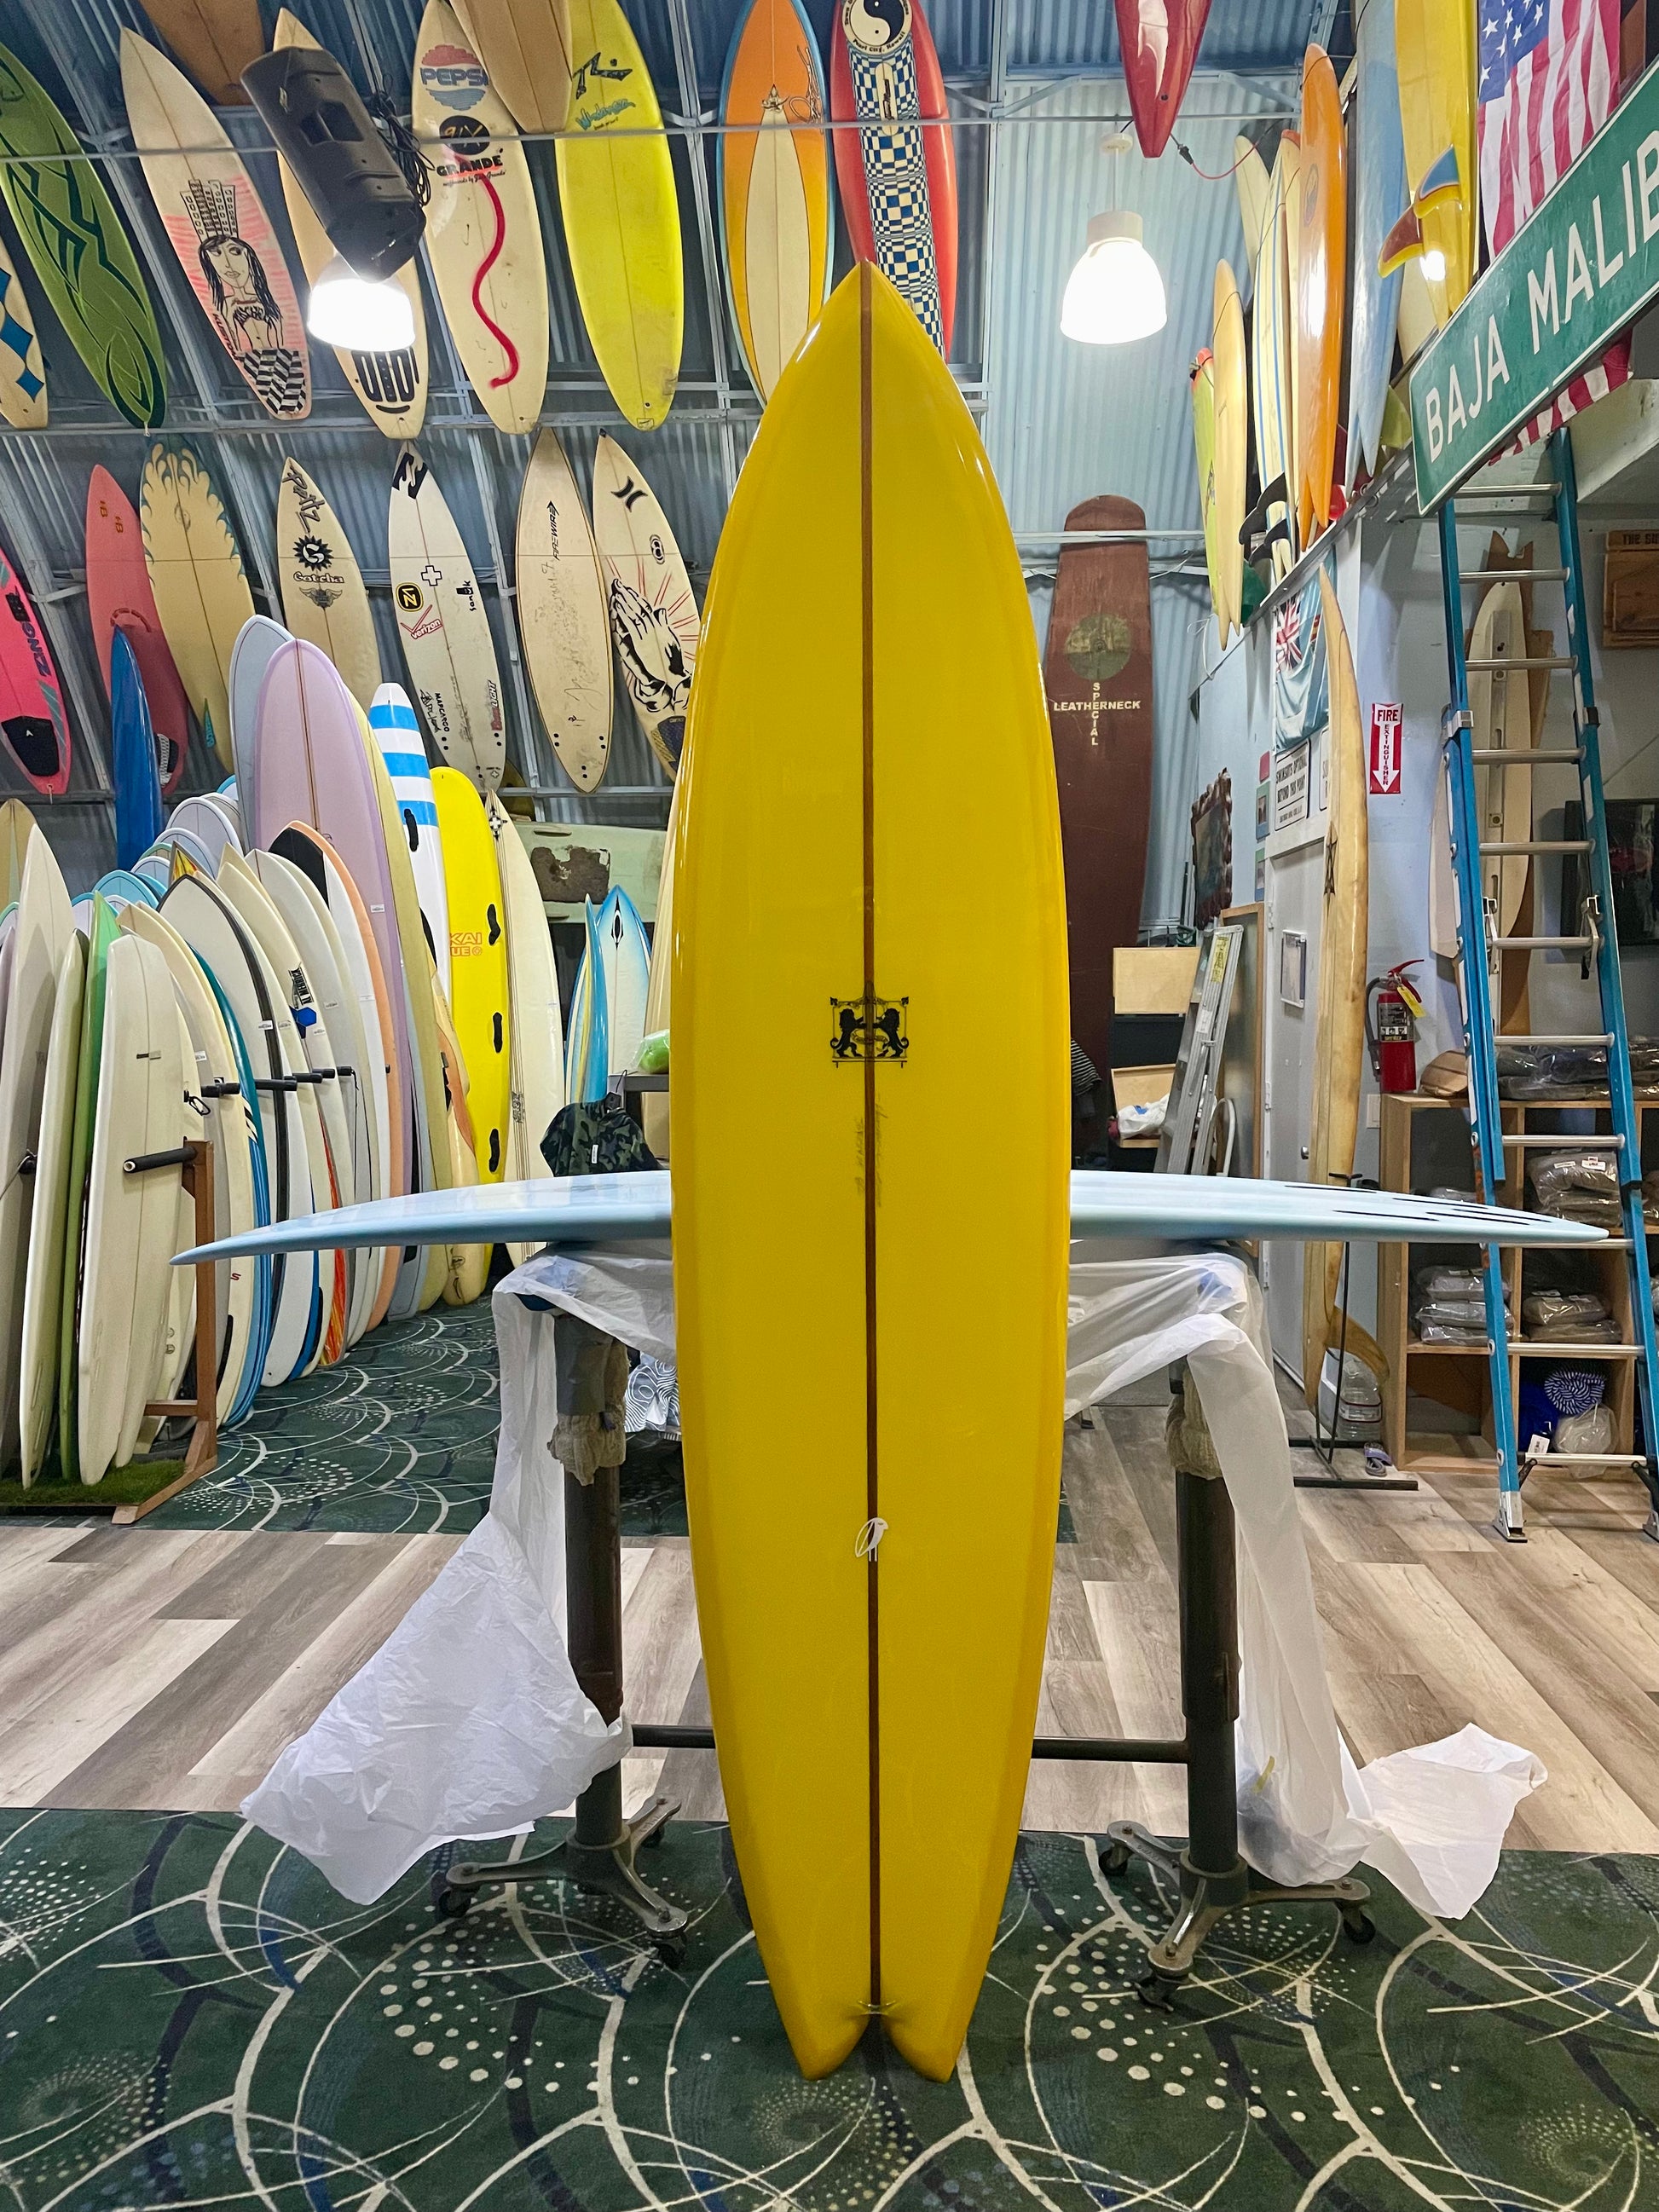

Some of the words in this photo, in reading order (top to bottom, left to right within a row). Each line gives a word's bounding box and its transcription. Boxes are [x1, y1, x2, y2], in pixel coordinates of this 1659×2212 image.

[436, 155, 503, 177] GRANDE
[1425, 313, 1510, 464] BAJA
[293, 571, 345, 584] Gotcha
[410, 618, 444, 640] verizon
[1053, 700, 1142, 712] LEATHERNECK
[1090, 682, 1101, 746] SPECIAL
[1377, 709, 1399, 722] FIRE
[1382, 724, 1390, 786] EXTINGUISHER
